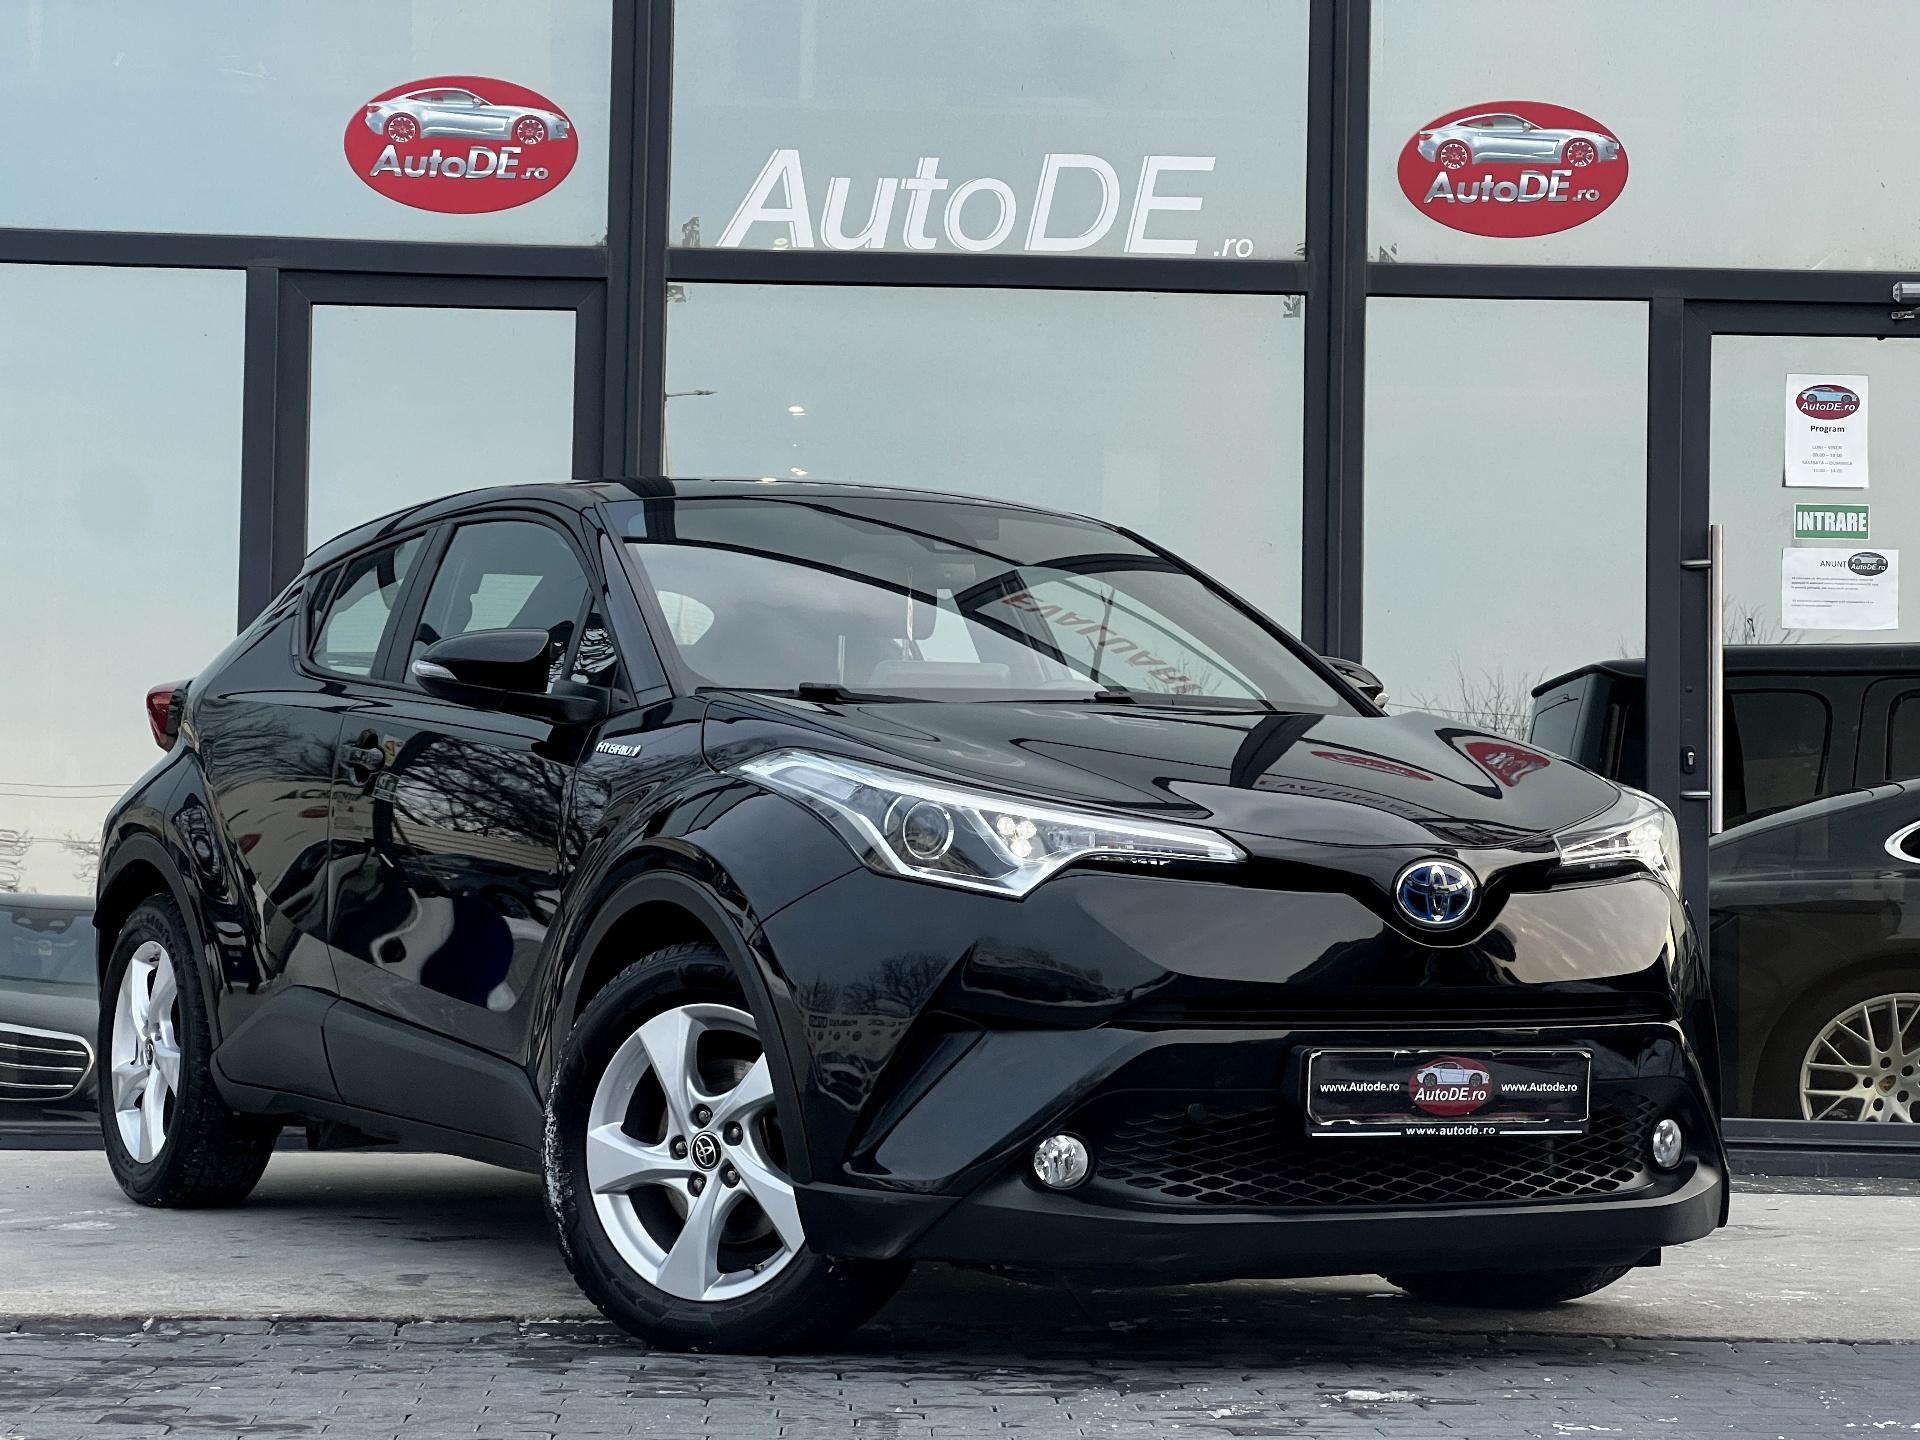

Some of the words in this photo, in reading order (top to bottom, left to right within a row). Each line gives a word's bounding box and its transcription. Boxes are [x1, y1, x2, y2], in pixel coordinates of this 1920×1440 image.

[1800, 402, 1856, 411] AutoDE.ro
[1810, 425, 1845, 433] Program
[1797, 511, 1867, 532] INTRARE
[1320, 1082, 1400, 1093] www.Autode.ro
[1414, 1087, 1487, 1101] AutoDE.ro
[1501, 1082, 1578, 1093] www.Autode.ro
[1405, 1125, 1496, 1136] www.autode.ro
